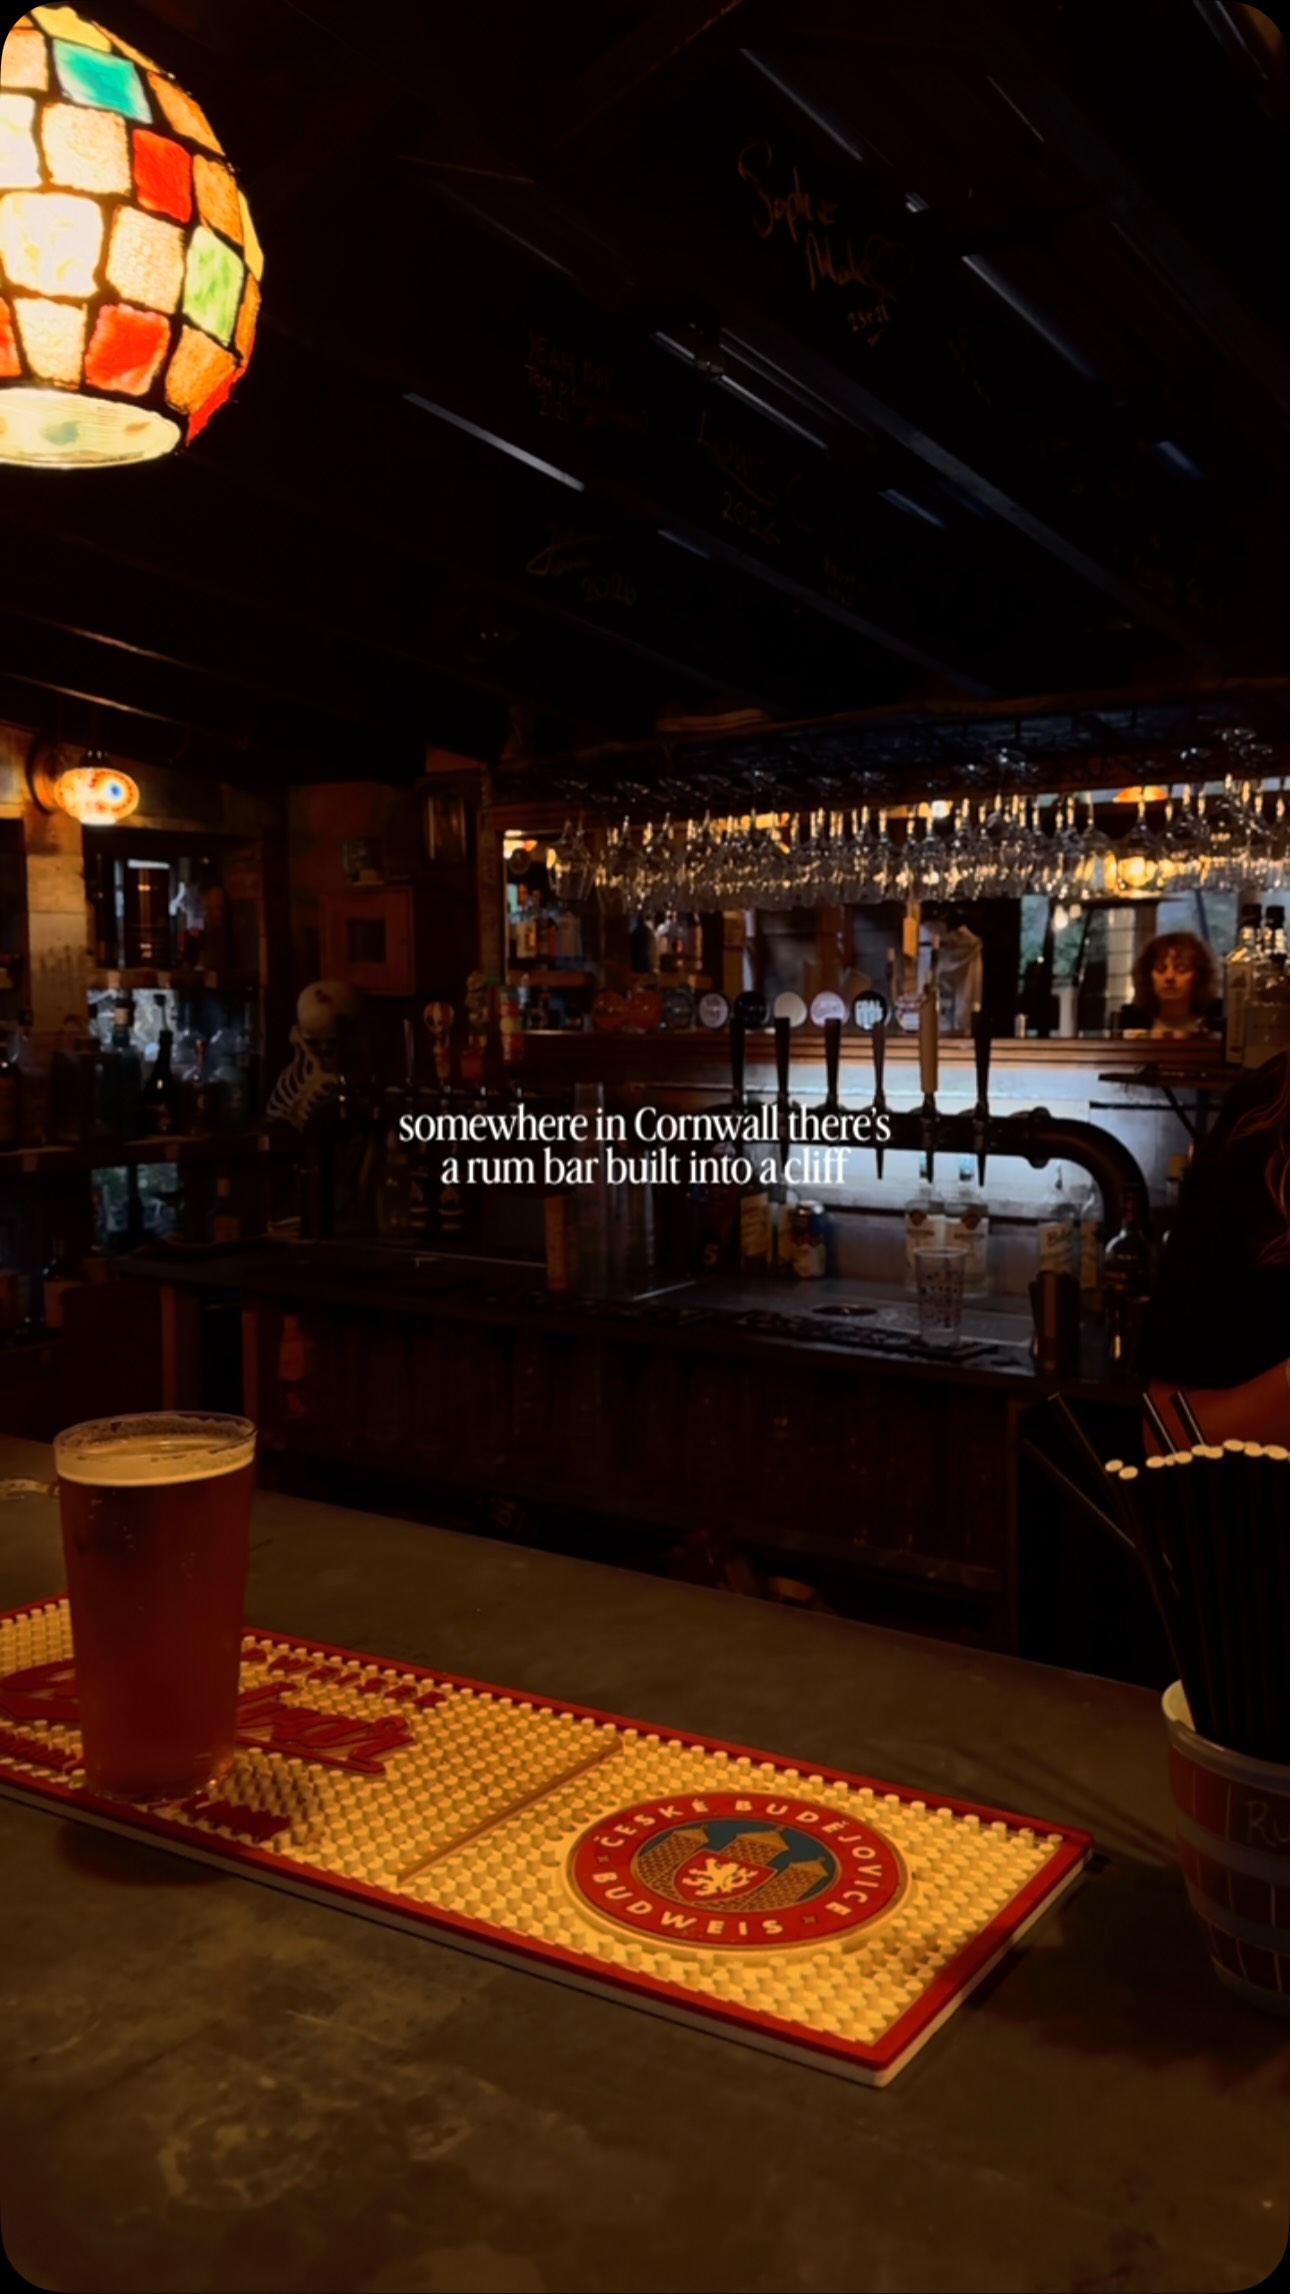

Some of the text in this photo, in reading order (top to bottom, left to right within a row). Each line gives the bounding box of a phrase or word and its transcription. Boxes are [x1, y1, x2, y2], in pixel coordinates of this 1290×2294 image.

[592, 1870, 784, 1936] BUDWEIS
[593, 1797, 884, 1918] ČESKÉ BUDĚJOVICE
